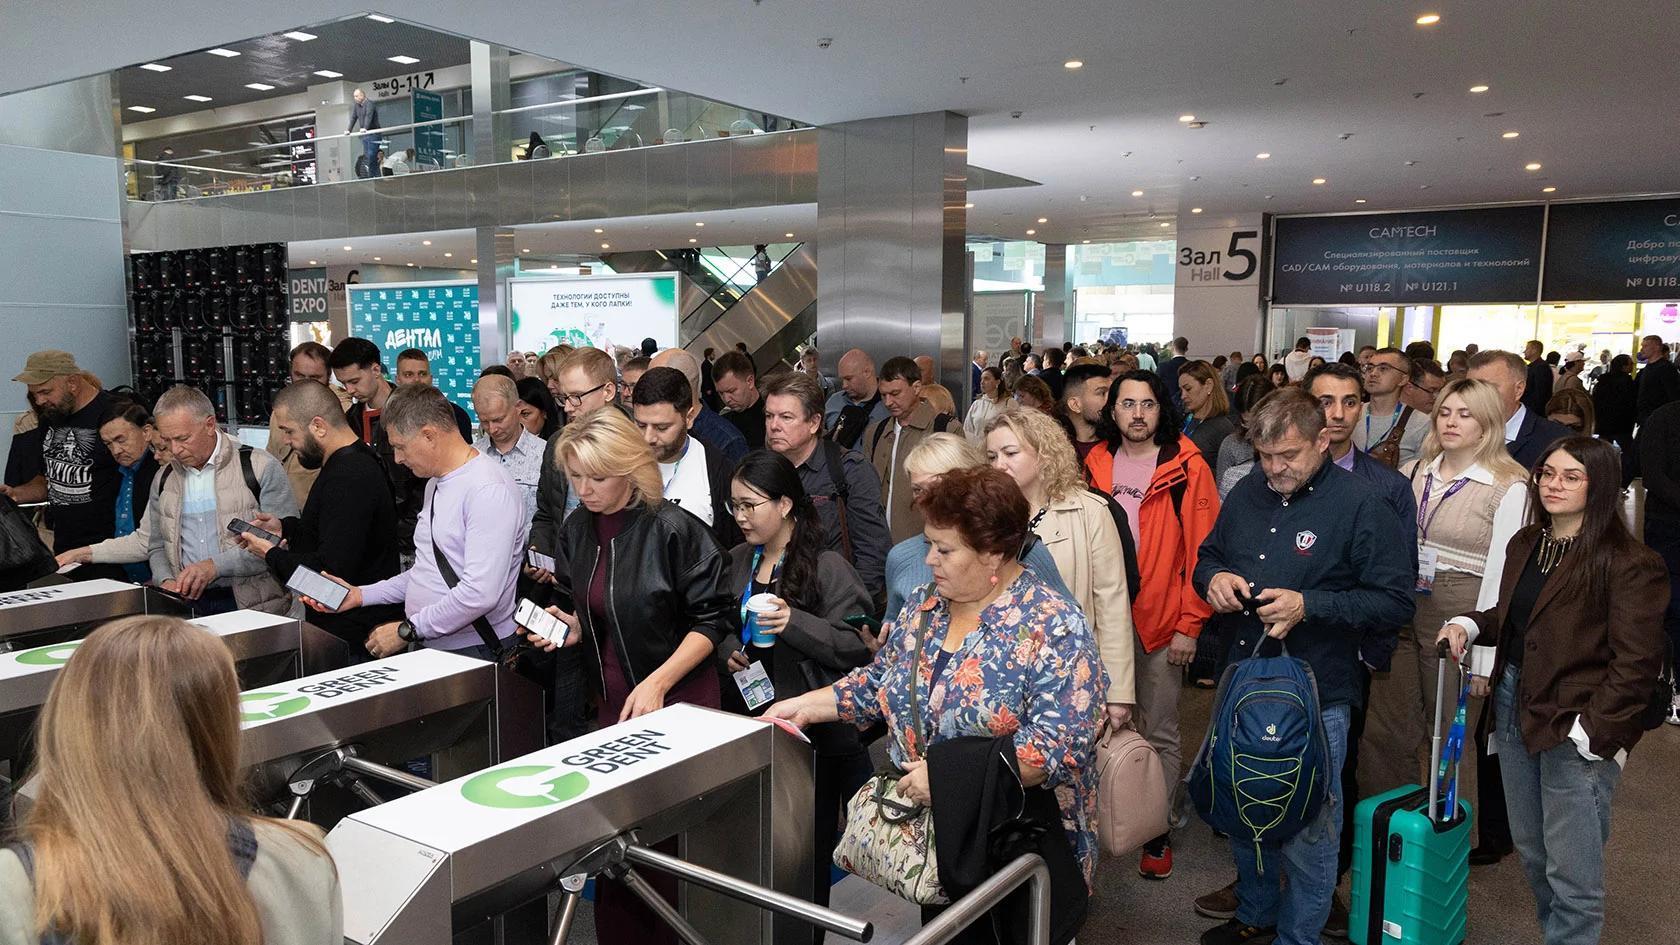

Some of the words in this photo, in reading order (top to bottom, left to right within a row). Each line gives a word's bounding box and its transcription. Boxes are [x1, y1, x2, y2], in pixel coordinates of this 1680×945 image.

[391, 74, 419, 95] 9-11
[1664, 214, 1680, 227] C
[1369, 225, 1437, 239] CAMTECH
[1626, 240, 1665, 250] Добро
[1668, 240, 1680, 248] по
[1180, 247, 1221, 266] Зал
[1223, 231, 1258, 281] 5
[1324, 249, 1425, 259] Специализированный
[1427, 248, 1480, 257] поставщик
[1628, 253, 1680, 265] цифрову
[1281, 263, 1331, 273] CAD/CAM
[1332, 262, 1401, 273] оборудования,
[1404, 260, 1461, 270] материалов
[1472, 258, 1530, 268] технологий
[1191, 267, 1221, 281] Hall
[1356, 283, 1391, 292] U118.2
[1422, 281, 1457, 292] U121.1
[553, 293, 593, 301] ТЕХНОЛОГИИ
[594, 292, 630, 300] ДОСТУПНЫ
[293, 297, 327, 313] EXPO
[551, 301, 569, 309] ДАЖЕ
[384, 327, 442, 350] ДЕНТАЛ
[47, 459, 93, 484] UTICAL
[297, 666, 400, 693] GREEN
[313, 674, 397, 698] DENT
[561, 729, 666, 766] GREEN
[585, 741, 672, 774] DENT
